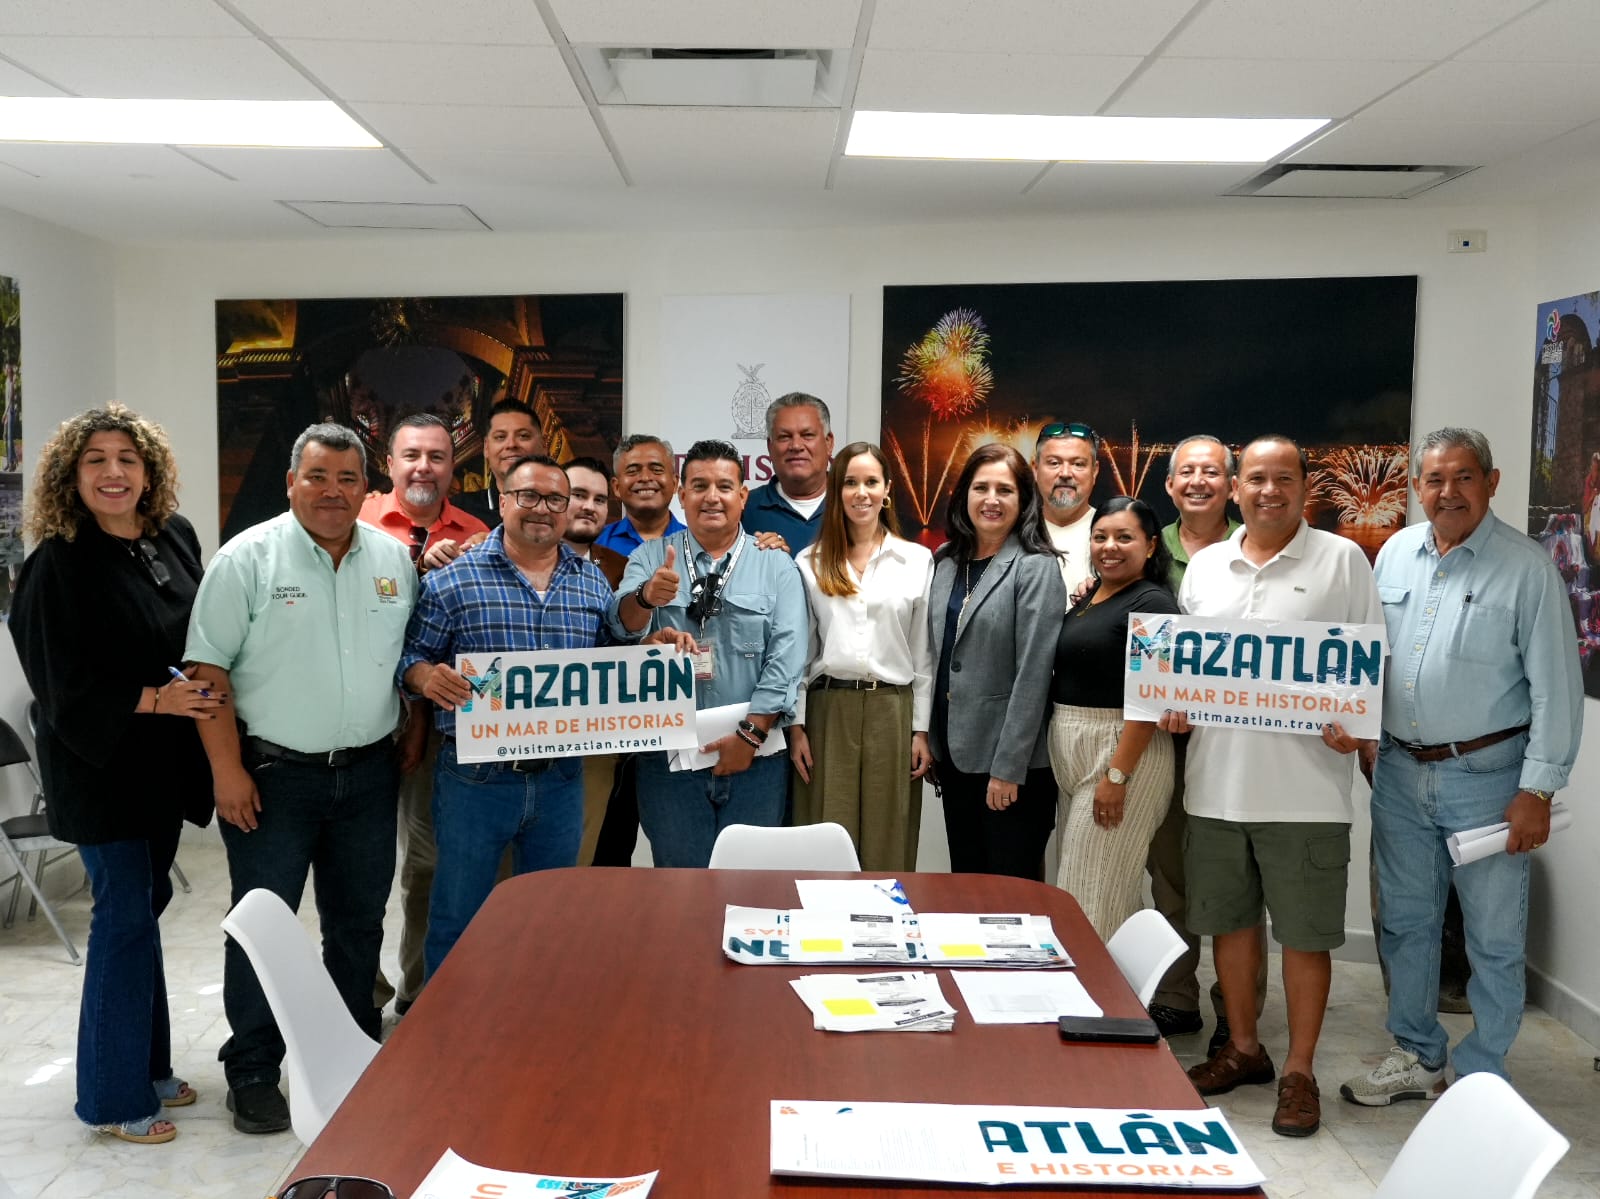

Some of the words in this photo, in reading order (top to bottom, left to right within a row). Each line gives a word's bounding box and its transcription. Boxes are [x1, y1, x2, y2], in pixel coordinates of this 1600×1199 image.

[1129, 617, 1381, 686] MAZATLÁN
[461, 648, 693, 713] MAZATLÁN
[1139, 684, 1166, 699] UN
[1174, 686, 1216, 704] MAR
[1223, 690, 1249, 706] DE
[1256, 692, 1367, 715] HISTORIAS
[471, 724, 499, 739] UN
[506, 720, 548, 737] MAR
[555, 718, 579, 734] DE
[586, 713, 684, 732] HISTORIAS
[498, 736, 663, 757] @visitmazatlan.travel
[978, 1113, 1239, 1155] ATLÁN
[1030, 1163, 1234, 1176] HISTORIAS
